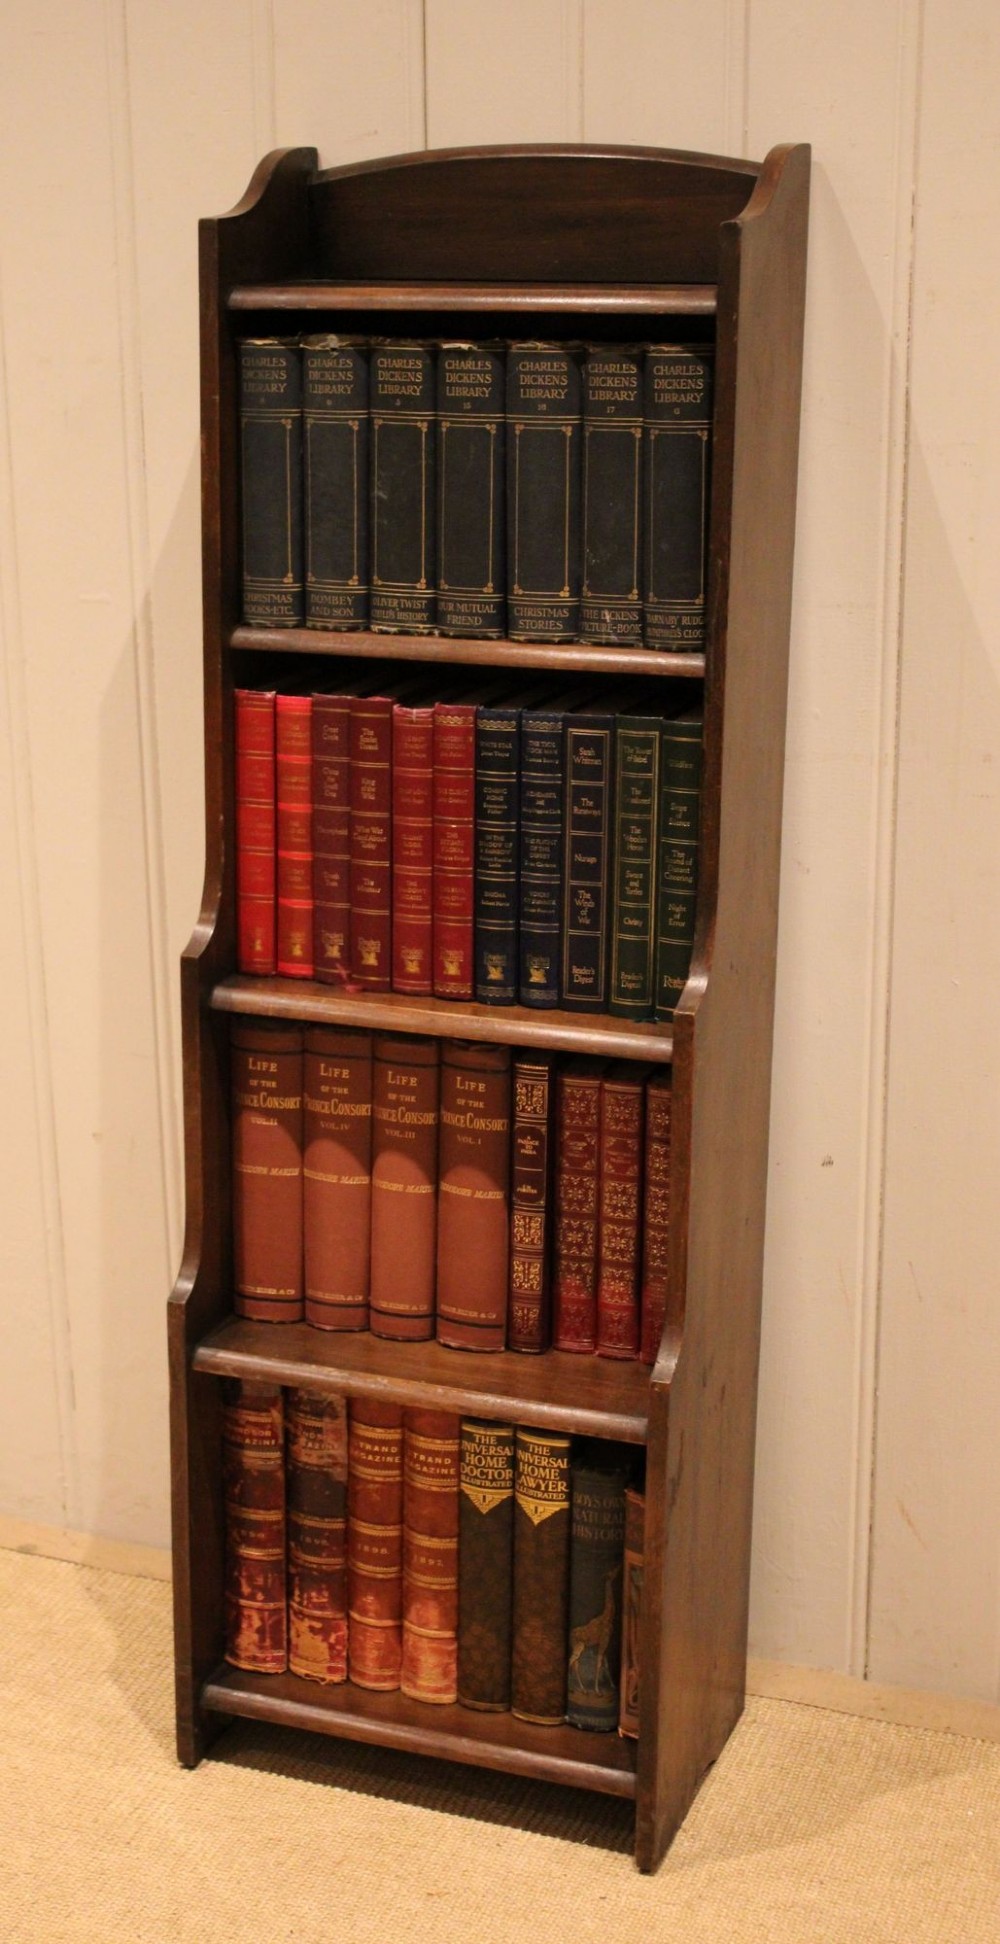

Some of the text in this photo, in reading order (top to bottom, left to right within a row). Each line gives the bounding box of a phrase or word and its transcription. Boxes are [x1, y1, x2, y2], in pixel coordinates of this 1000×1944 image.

[307, 357, 354, 368] CHARLES
[377, 358, 423, 369] CHARLES
[445, 360, 493, 371] CHARLES
[518, 361, 568, 372] CHARLES
[588, 363, 638, 374] CHARLES
[308, 371, 354, 381] DICKENS
[378, 370, 424, 382] DICKENS
[653, 365, 704, 376] CHARLES
[446, 373, 493, 384] DICKENS
[519, 374, 569, 385] DICKENS
[588, 376, 638, 388] DICKENS
[653, 378, 705, 390] DICKENS
[309, 384, 355, 395] LIBRARY
[378, 384, 424, 396] LIBRARY
[446, 386, 493, 398] LIBRARY
[520, 388, 568, 399] LIBRARY
[589, 390, 638, 401] LIBRARY
[654, 392, 705, 403] LIBRARY
[310, 594, 354, 606] DOMBEY
[398, 598, 427, 610] TWIST
[332, 607, 354, 617] SON
[457, 602, 496, 614] MUTUAL
[514, 607, 570, 618] CHRISTMAS
[397, 610, 429, 622] HISTORY
[446, 613, 482, 626] FRIEND
[582, 608, 639, 622] THE DICKENS
[519, 620, 564, 631] STORIES
[681, 616, 704, 627] RUDG
[683, 628, 704, 639] CLOC
[581, 797, 594, 807] The
[577, 890, 592, 900] The
[572, 965, 596, 976] Reader's
[573, 974, 594, 985] Digest
[663, 975, 687, 987] Reader
[248, 1057, 278, 1073] LIFE
[320, 1063, 351, 1079] LIFE
[261, 1080, 278, 1088] THE
[387, 1070, 418, 1087] LIFE
[456, 1076, 487, 1093] LIFE
[333, 1086, 349, 1095] THE
[259, 1091, 302, 1110] CONSORT
[400, 1094, 417, 1103] THE
[468, 1099, 485, 1109] THE
[331, 1098, 372, 1117] CONSORT
[397, 1106, 436, 1125] CONSOR
[466, 1112, 509, 1132] CONSORT
[244, 1438, 277, 1446] AZINE
[473, 1434, 498, 1445] THE
[359, 1441, 398, 1453] TRAND
[528, 1444, 551, 1456] THE
[359, 1452, 401, 1464] GAZINE
[413, 1452, 452, 1465] TRAND
[465, 1453, 507, 1469] HOME
[460, 1462, 514, 1480] DOCTOR
[519, 1462, 560, 1480] HOME
[461, 1475, 514, 1488] ILLUSTRATED
[519, 1475, 568, 1492] AWYER
